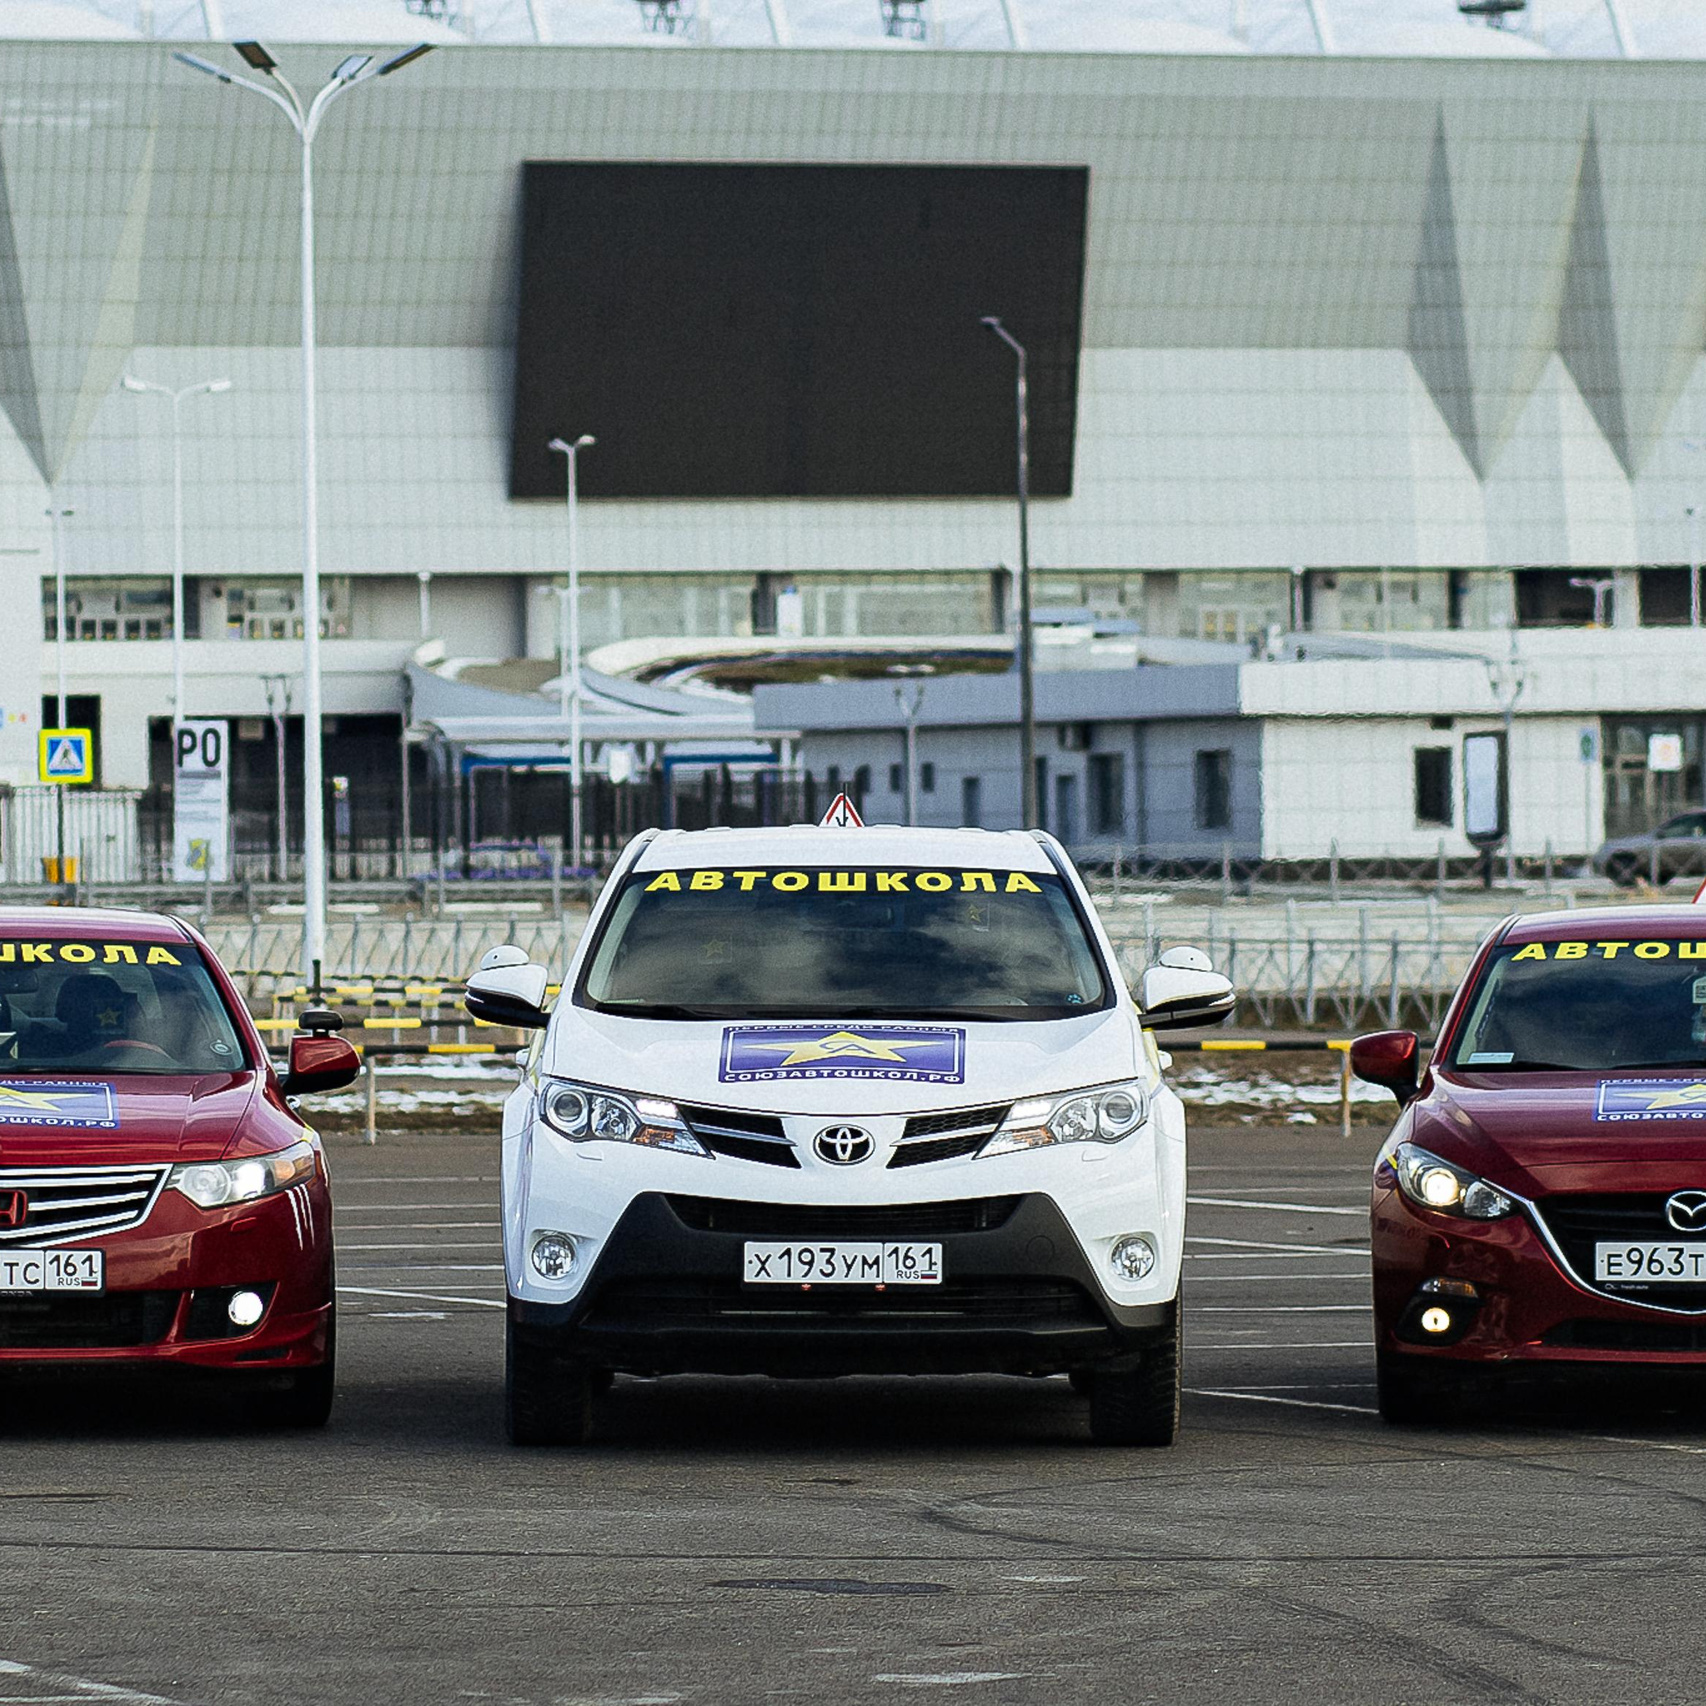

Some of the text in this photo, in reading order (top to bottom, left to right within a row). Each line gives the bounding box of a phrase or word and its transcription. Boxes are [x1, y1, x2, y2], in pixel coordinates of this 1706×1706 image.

[644, 871, 1043, 893] АВТОШКОЛА
[724, 1069, 961, 1083] СОЮЗАВТОШКОЛ.РФ
[1597, 1113, 1704, 1121] СОЮЗАВТО
[48, 1254, 94, 1277] 161
[887, 1246, 935, 1271] 161
[57, 1277, 80, 1286] RUS
[897, 1270, 920, 1279] RUS
